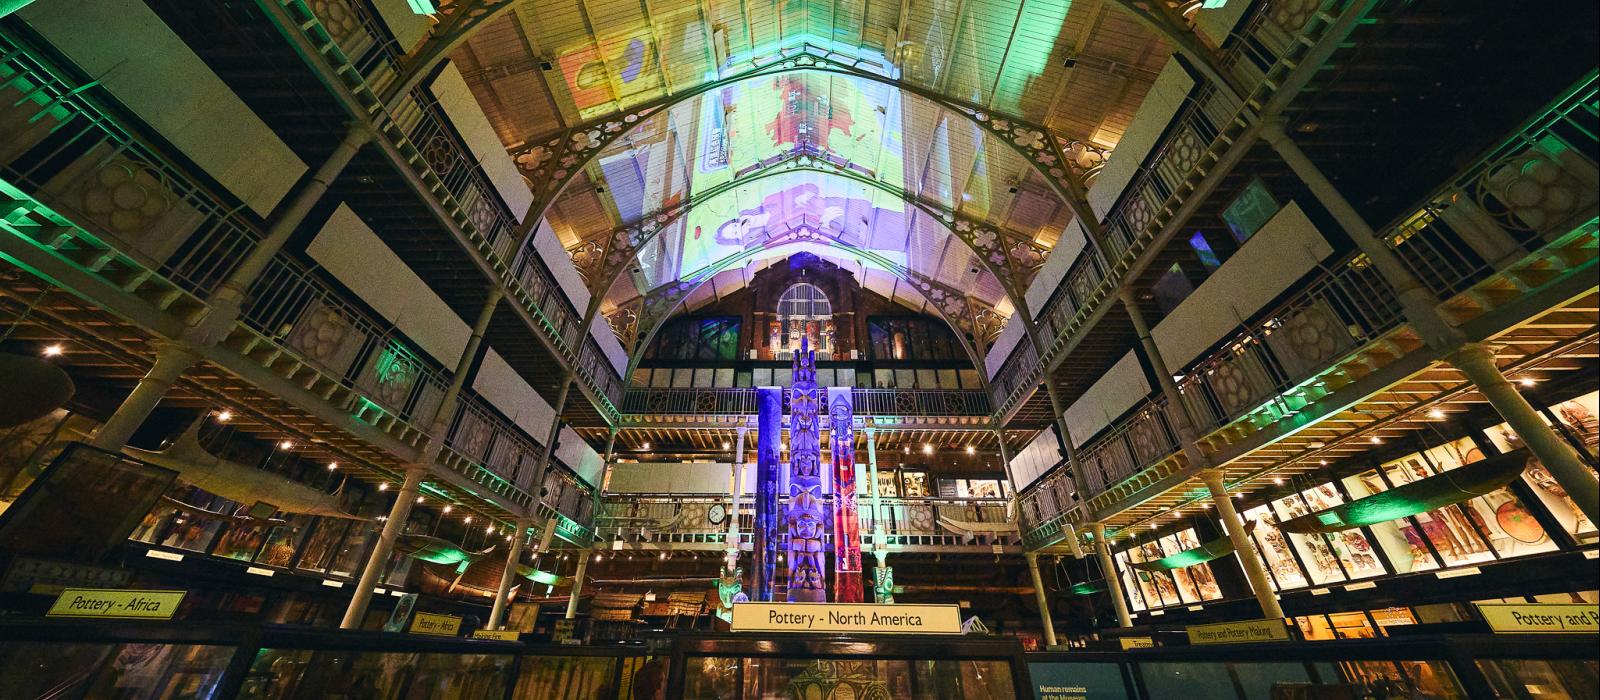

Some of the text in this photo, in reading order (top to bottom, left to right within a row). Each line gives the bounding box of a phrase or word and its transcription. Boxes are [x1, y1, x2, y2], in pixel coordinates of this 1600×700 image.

[69, 596, 115, 614] Pottery
[124, 597, 161, 612] Africa
[768, 610, 815, 628] Pottery
[828, 611, 866, 625] North
[870, 612, 923, 626] America
[1512, 611, 1565, 629] Pottery
[1566, 611, 1592, 625] and
[1226, 627, 1249, 640] Pottery
[1248, 624, 1274, 638] Making
[1039, 684, 1087, 693] Human remains
